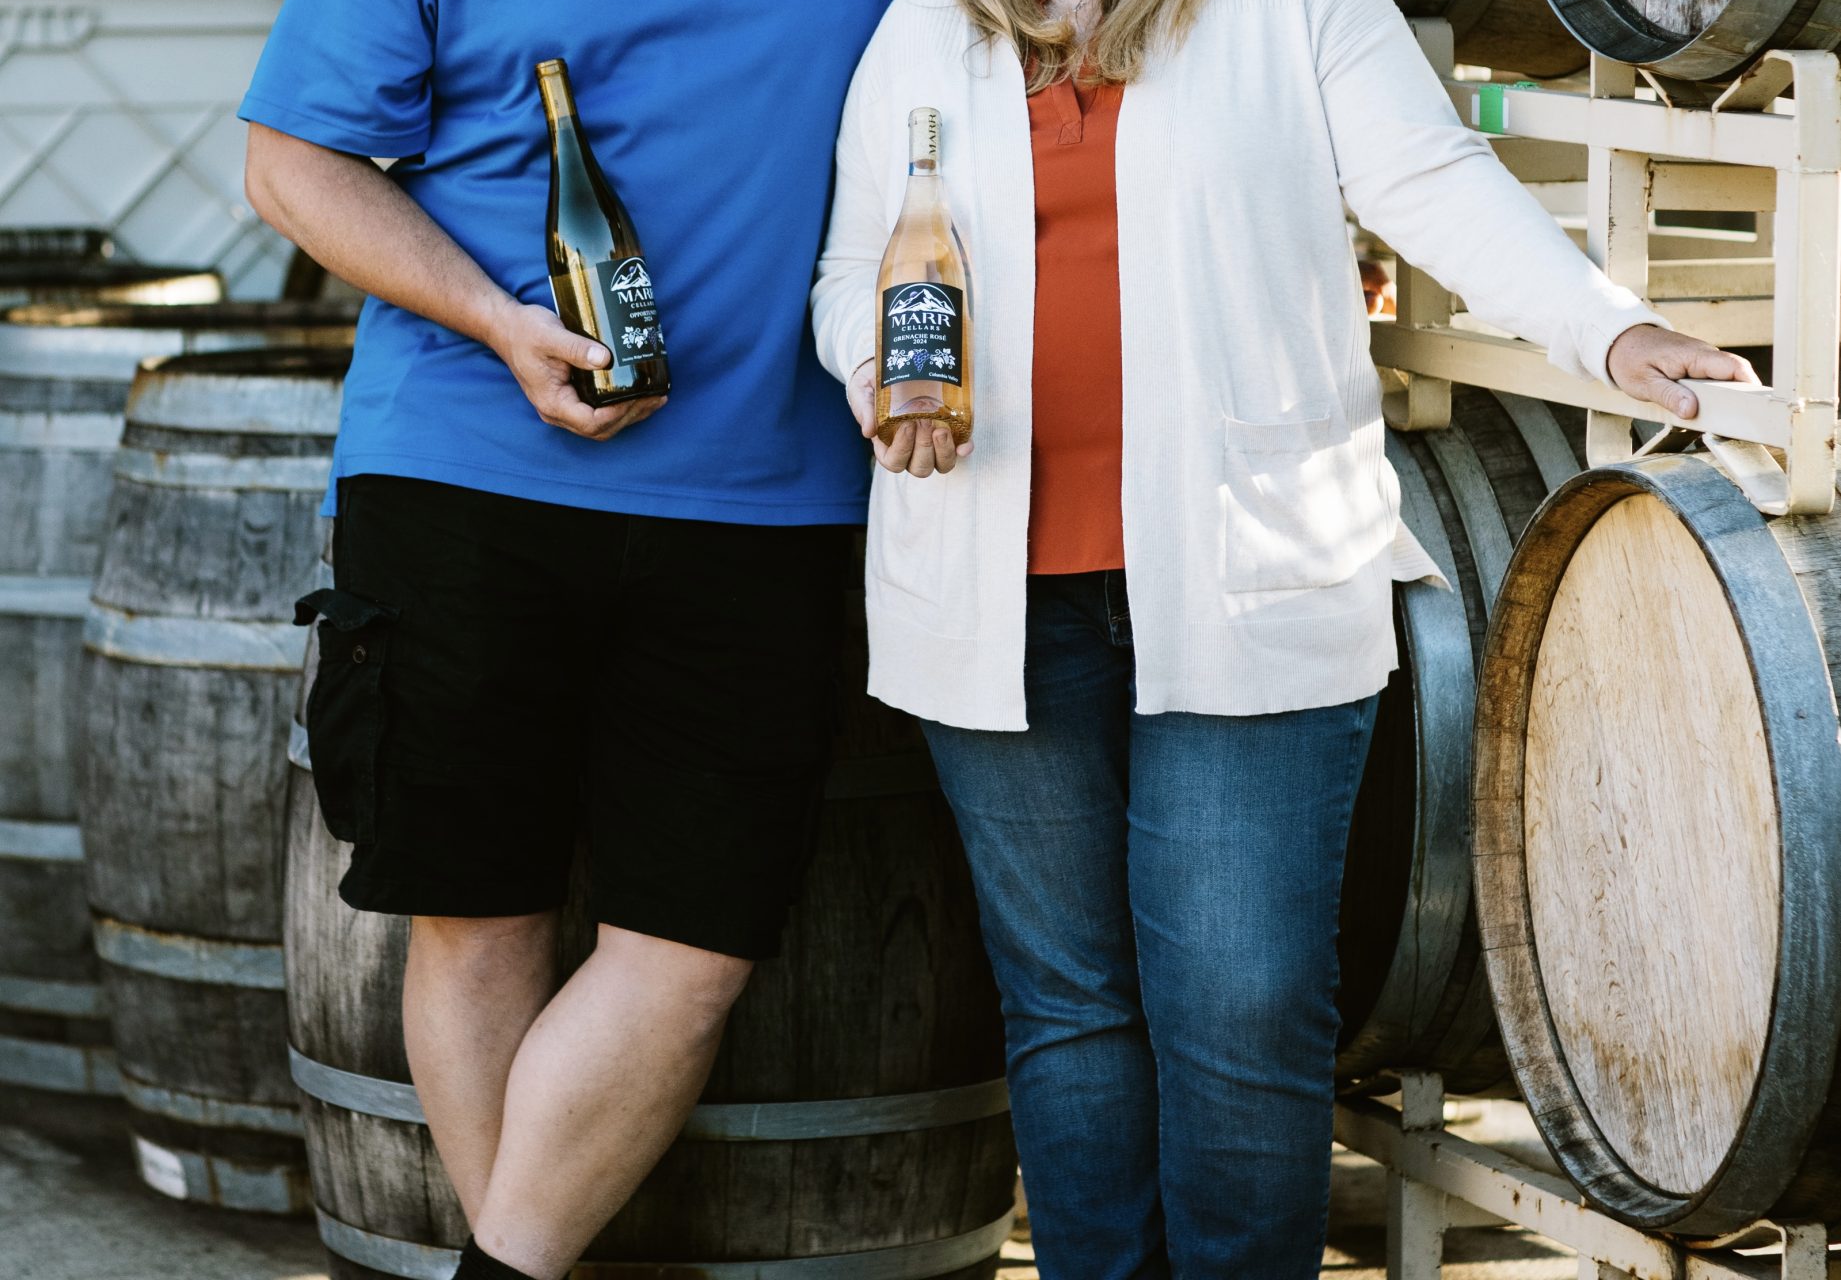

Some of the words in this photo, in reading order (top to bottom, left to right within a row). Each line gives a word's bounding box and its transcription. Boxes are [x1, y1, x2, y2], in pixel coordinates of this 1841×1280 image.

[928, 114, 937, 154] MARR
[617, 287, 654, 304] MAR
[891, 312, 952, 329] MARR
[893, 333, 929, 343] GRENACHE
[929, 333, 947, 342] ROSÉ
